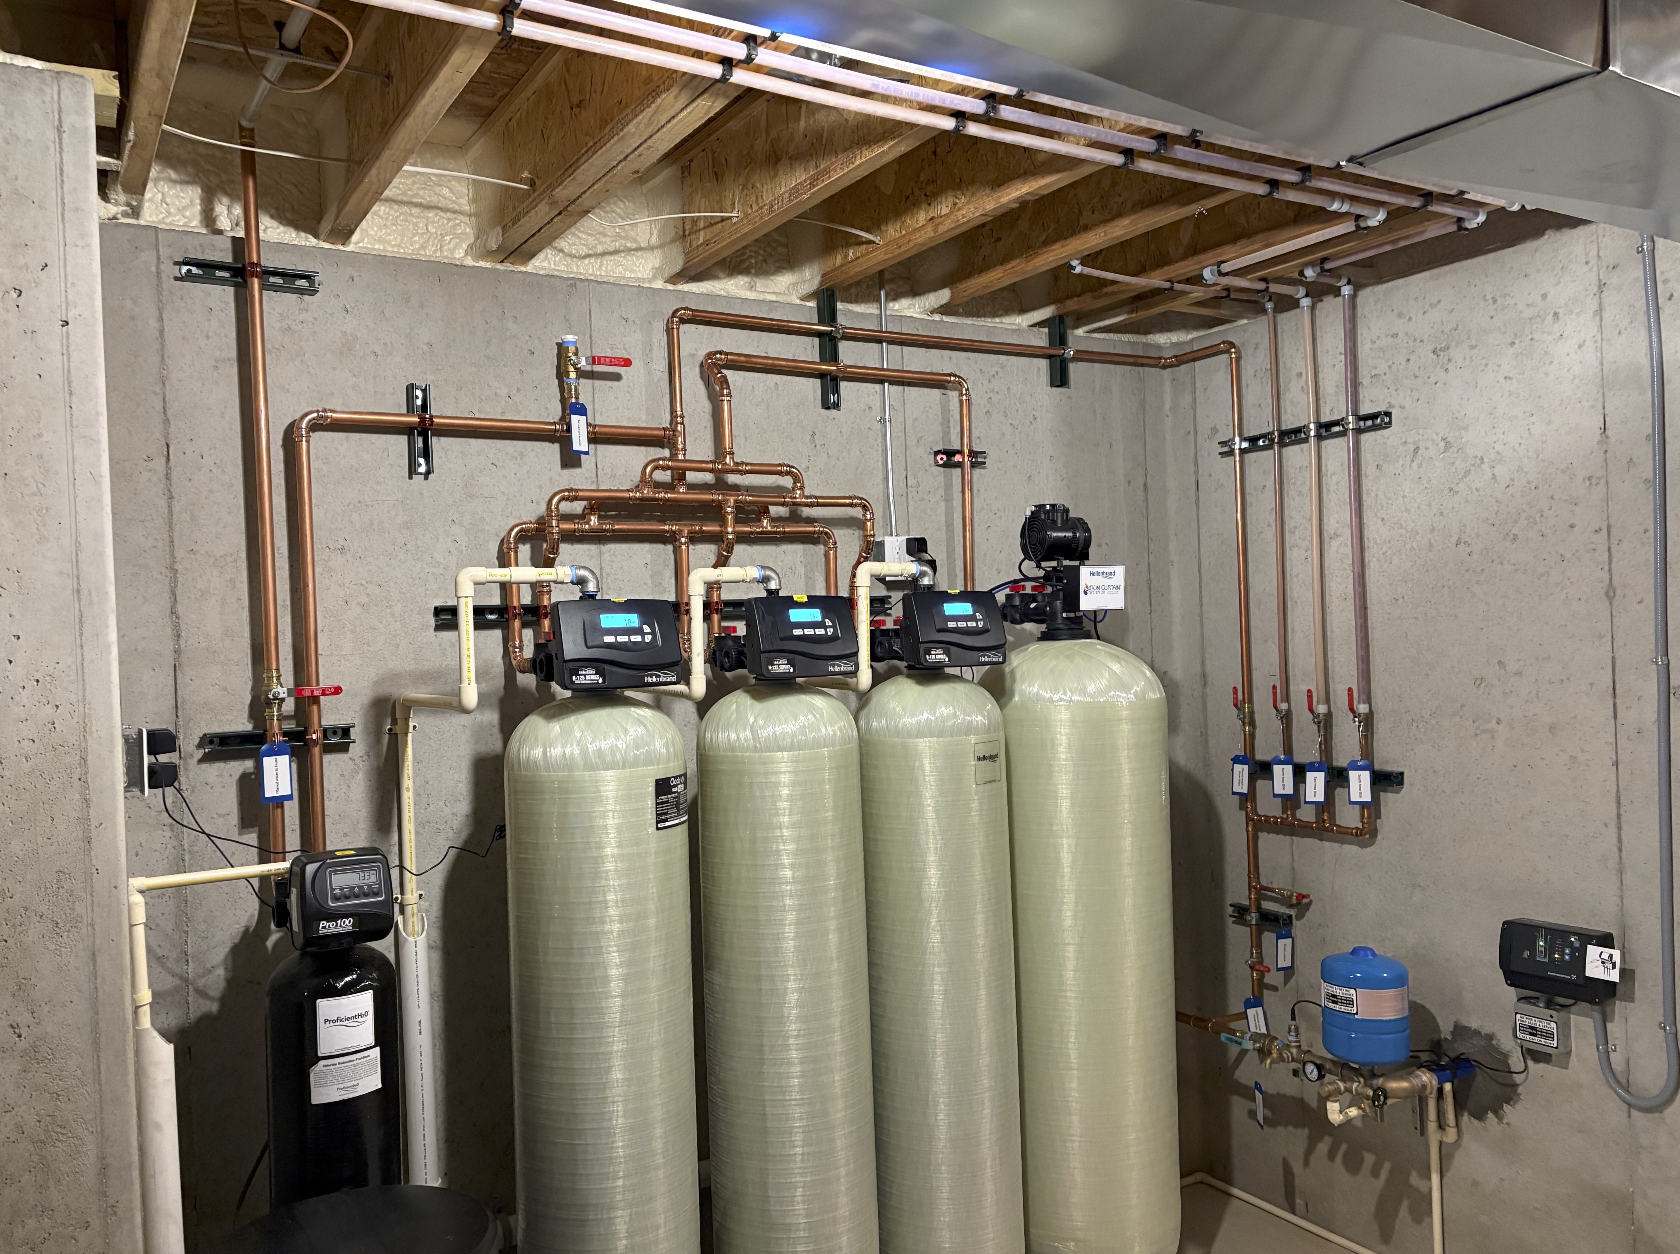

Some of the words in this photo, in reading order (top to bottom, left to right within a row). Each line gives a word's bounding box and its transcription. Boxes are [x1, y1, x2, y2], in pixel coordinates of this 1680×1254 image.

[828, 664, 855, 672] Hellenbrand
[644, 675, 677, 683] Hellenbrand
[356, 872, 371, 881] 733
[319, 918, 353, 930] Pro100
